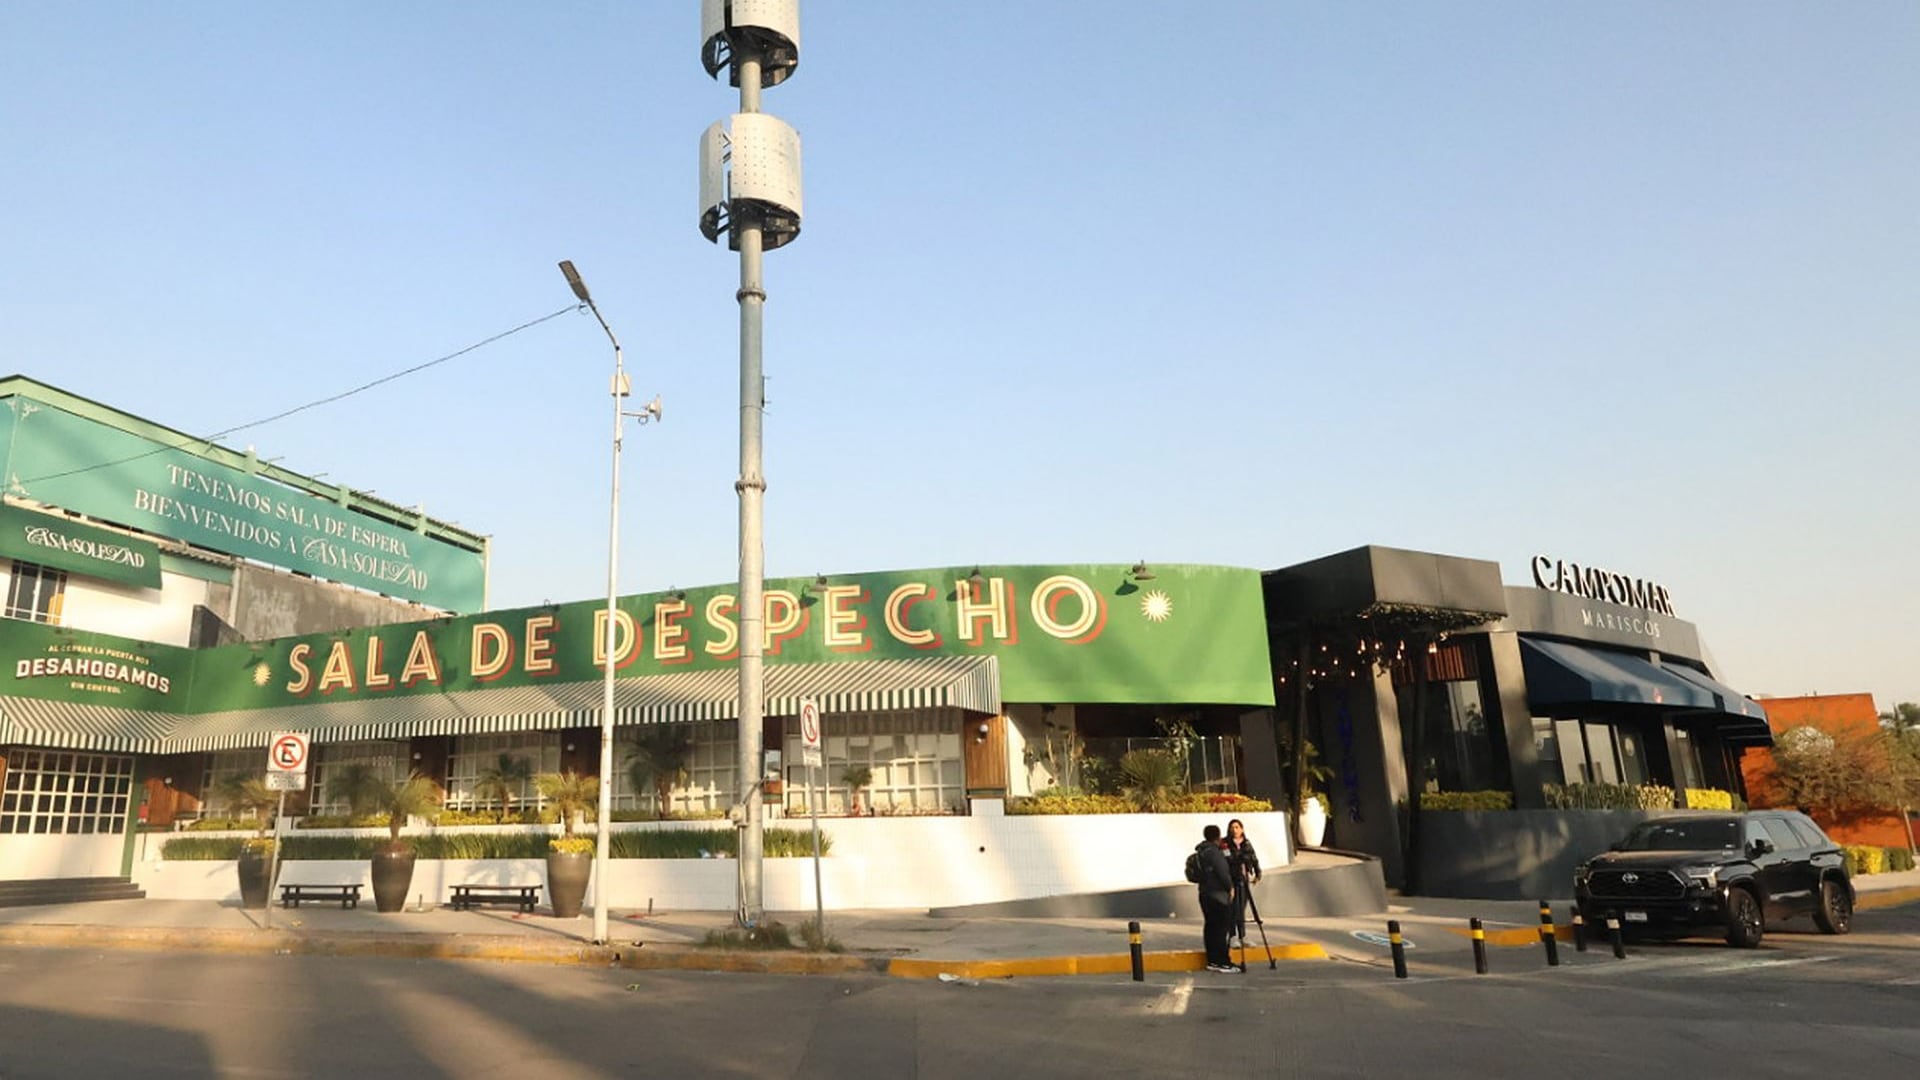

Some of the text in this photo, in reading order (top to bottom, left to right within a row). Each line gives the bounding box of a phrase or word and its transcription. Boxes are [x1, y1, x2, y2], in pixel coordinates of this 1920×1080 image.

[135, 489, 281, 549] BIENVENIDOS
[284, 536, 297, 554] A
[167, 464, 410, 559] TENEMOS SALA DE ESPERA
[1531, 554, 1676, 618] CAMPOMAR
[287, 575, 1104, 695] SALA DE DESPECHO
[1581, 608, 1660, 638] MARISCOS
[16, 658, 171, 694] DESAHOGAMOS
